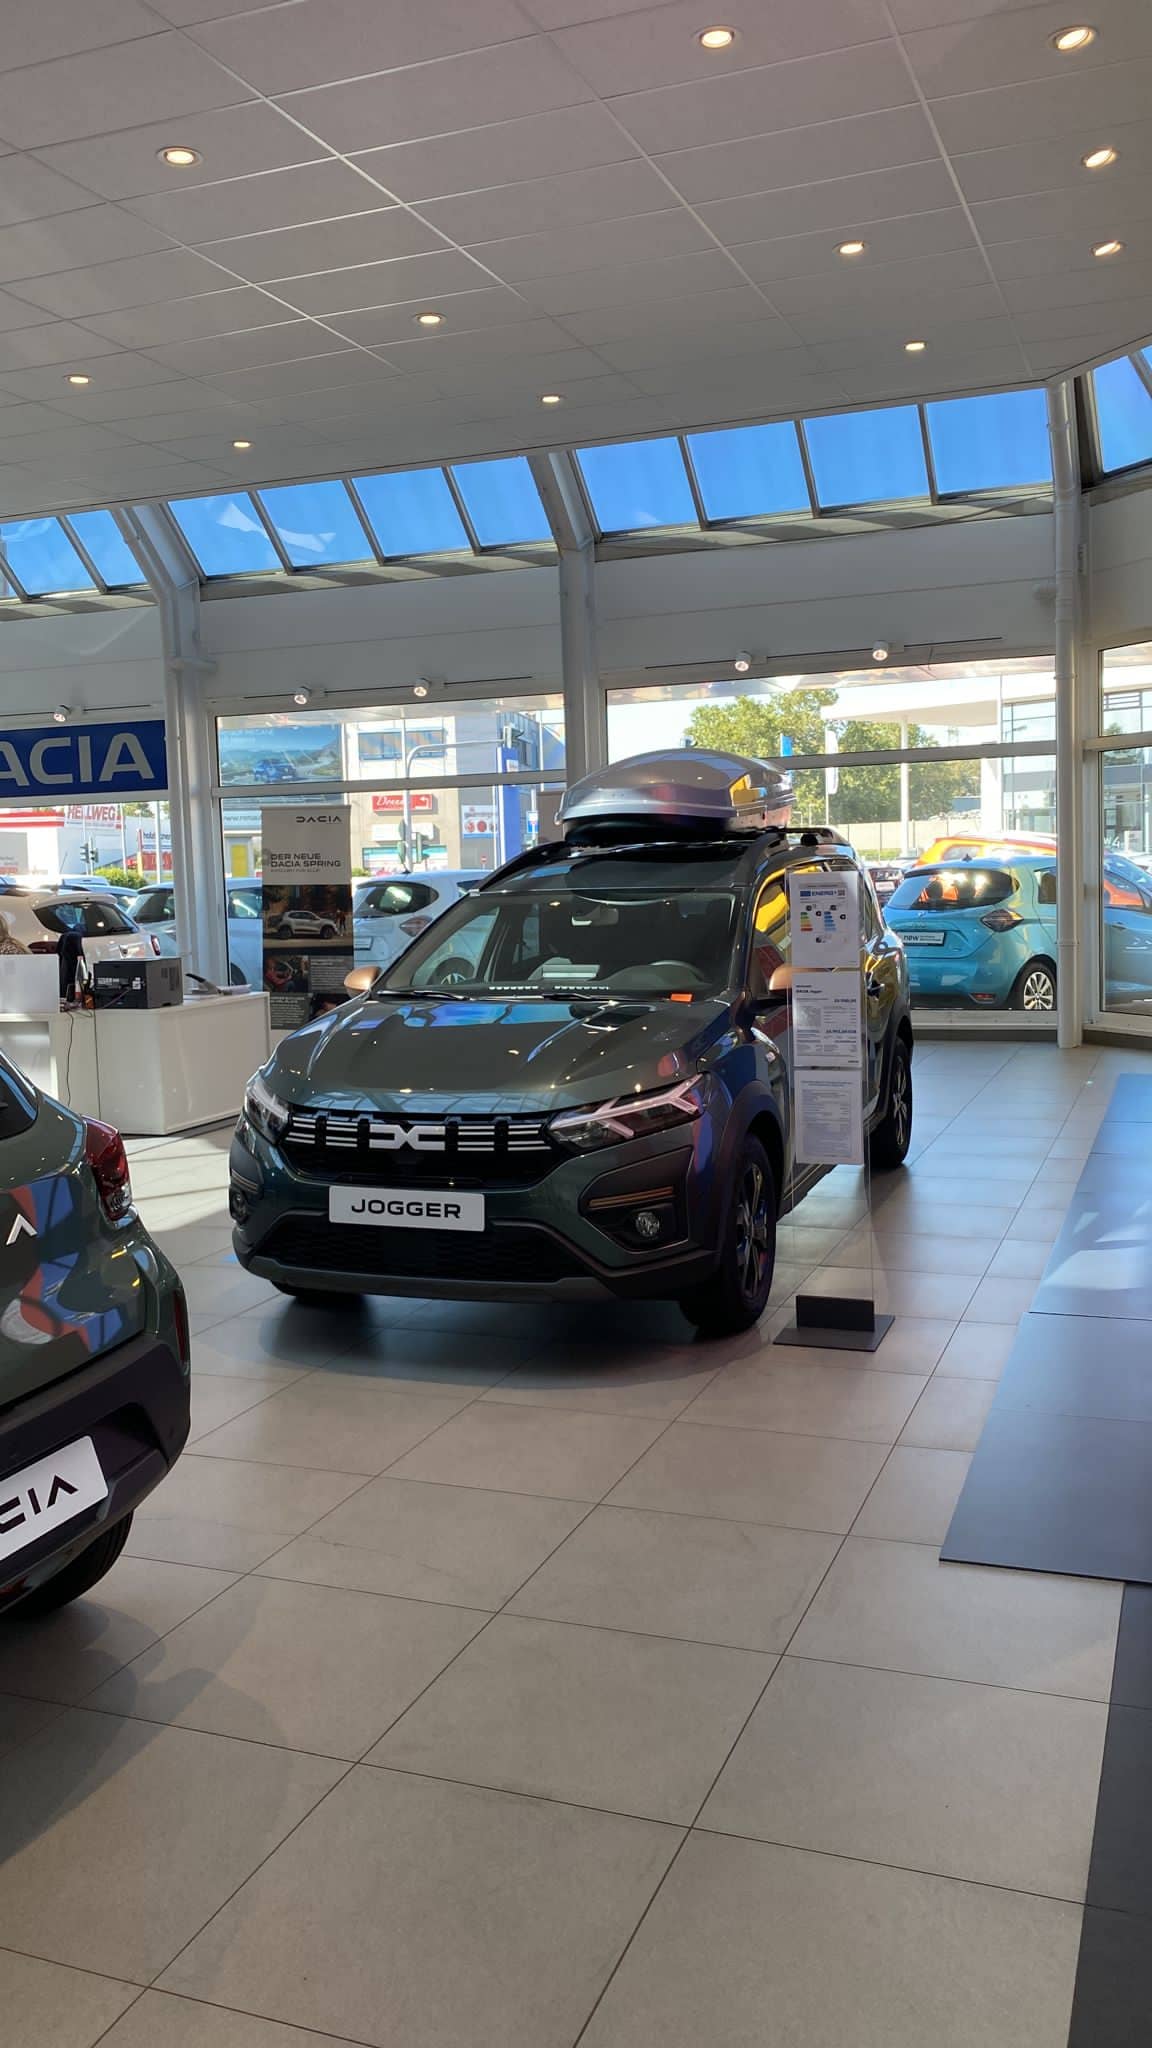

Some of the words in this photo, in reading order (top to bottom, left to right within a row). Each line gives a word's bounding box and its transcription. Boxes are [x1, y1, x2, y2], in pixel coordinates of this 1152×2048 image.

[296, 815, 342, 823] DACIA
[270, 860, 301, 868] DACIA
[351, 1198, 461, 1219] JOGGER
